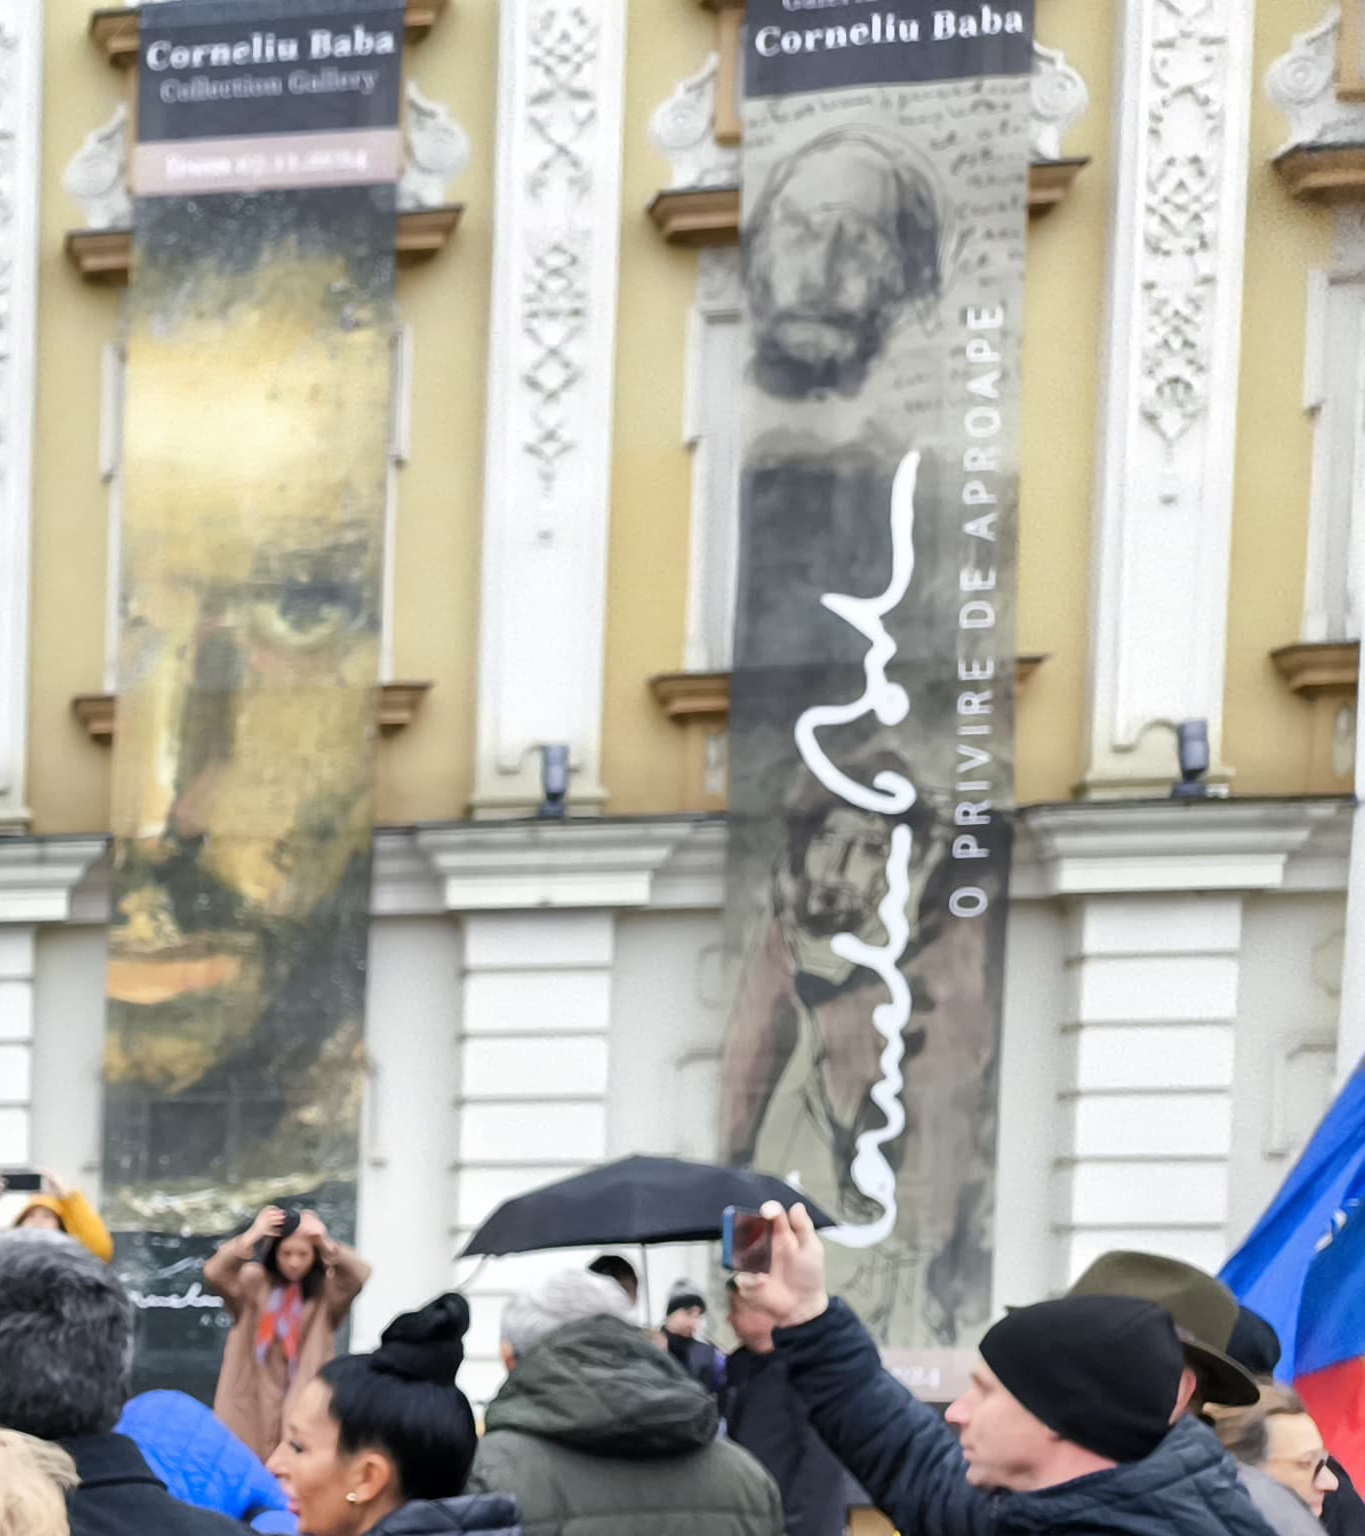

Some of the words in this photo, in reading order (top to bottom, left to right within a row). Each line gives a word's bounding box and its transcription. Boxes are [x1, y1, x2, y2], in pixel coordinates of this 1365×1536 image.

[145, 31, 300, 71] Corneliu
[308, 23, 396, 60] Baba
[755, 12, 920, 57] Corneliu
[932, 4, 1023, 41] Baba
[288, 67, 378, 95] Gallery
[962, 304, 1005, 542] APROAPE
[959, 566, 997, 629] DE
[952, 657, 995, 860] PRIVIRE
[949, 886, 989, 918] O
